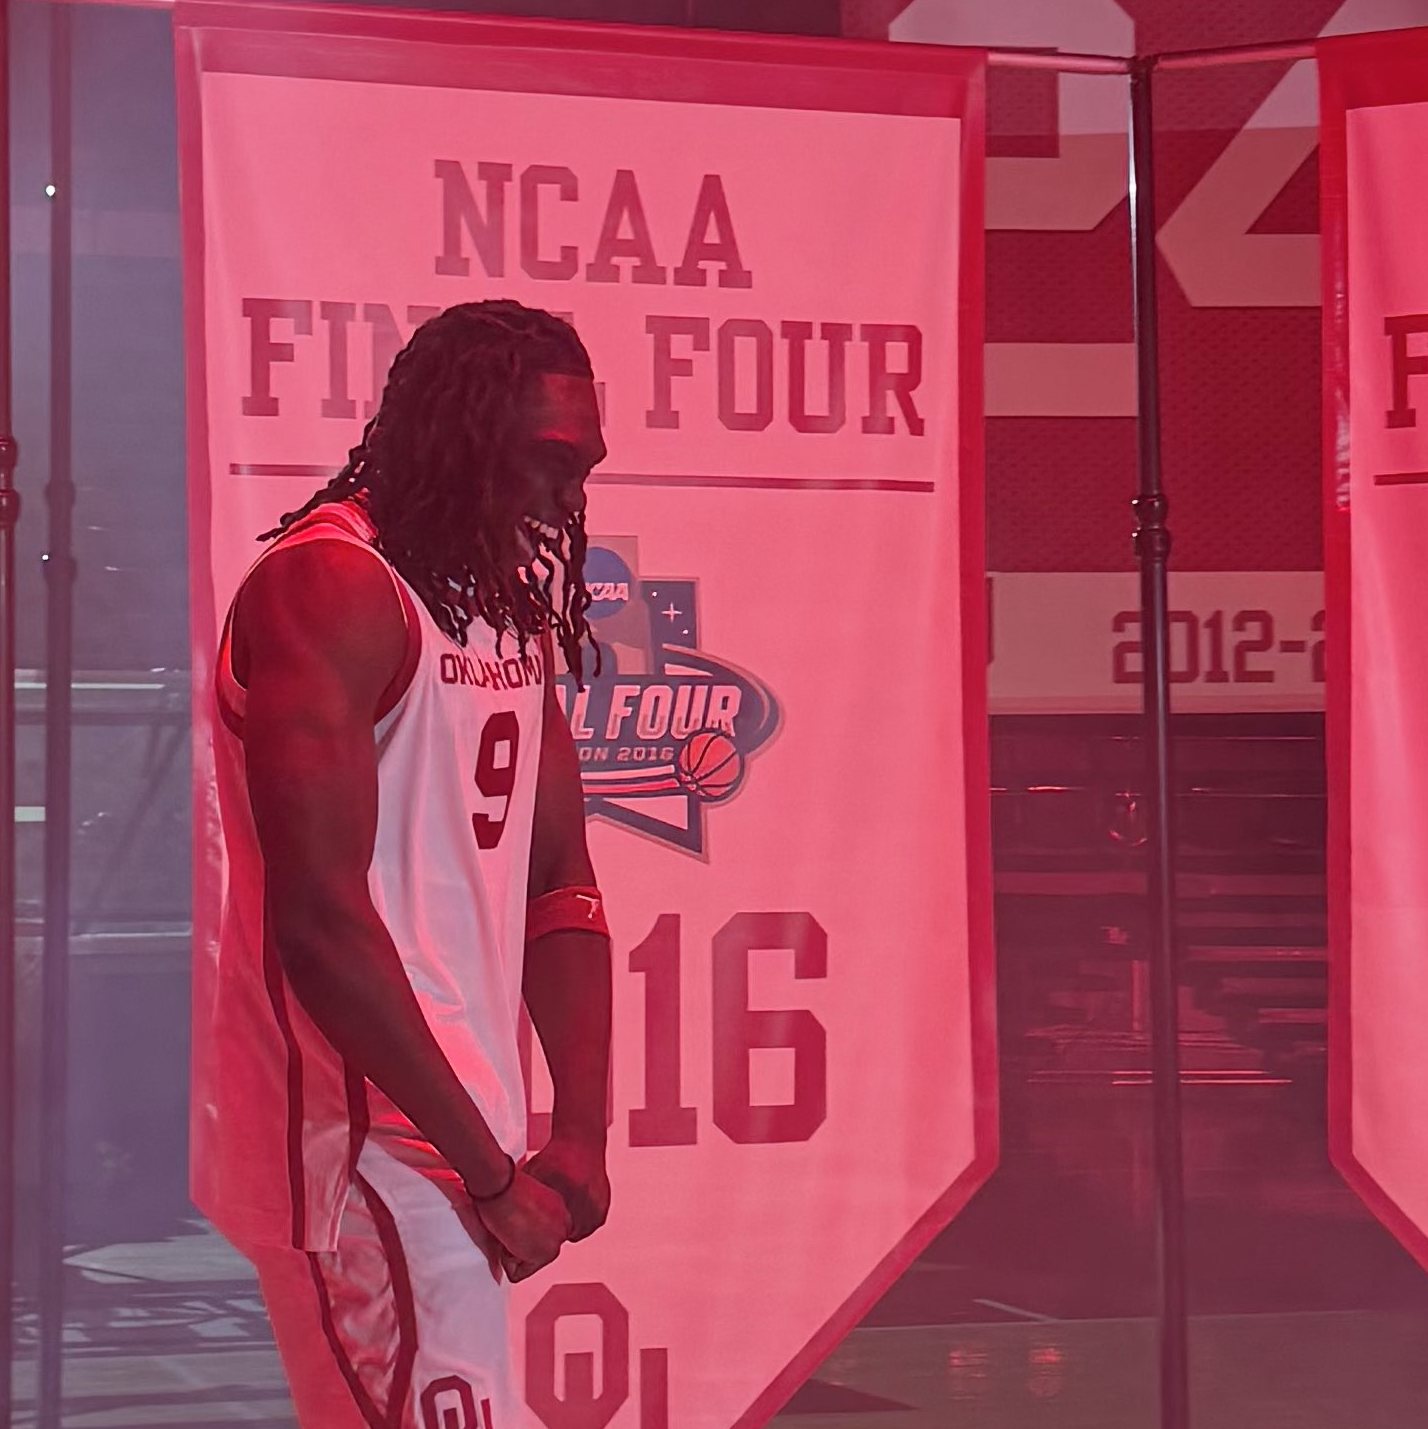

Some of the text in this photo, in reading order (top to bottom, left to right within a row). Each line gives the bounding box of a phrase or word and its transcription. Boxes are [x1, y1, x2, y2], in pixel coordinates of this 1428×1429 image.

[434, 159, 753, 289] NCAA
[645, 314, 925, 437] FOUR
[605, 684, 741, 740] FOUR
[472, 710, 520, 851] 9
